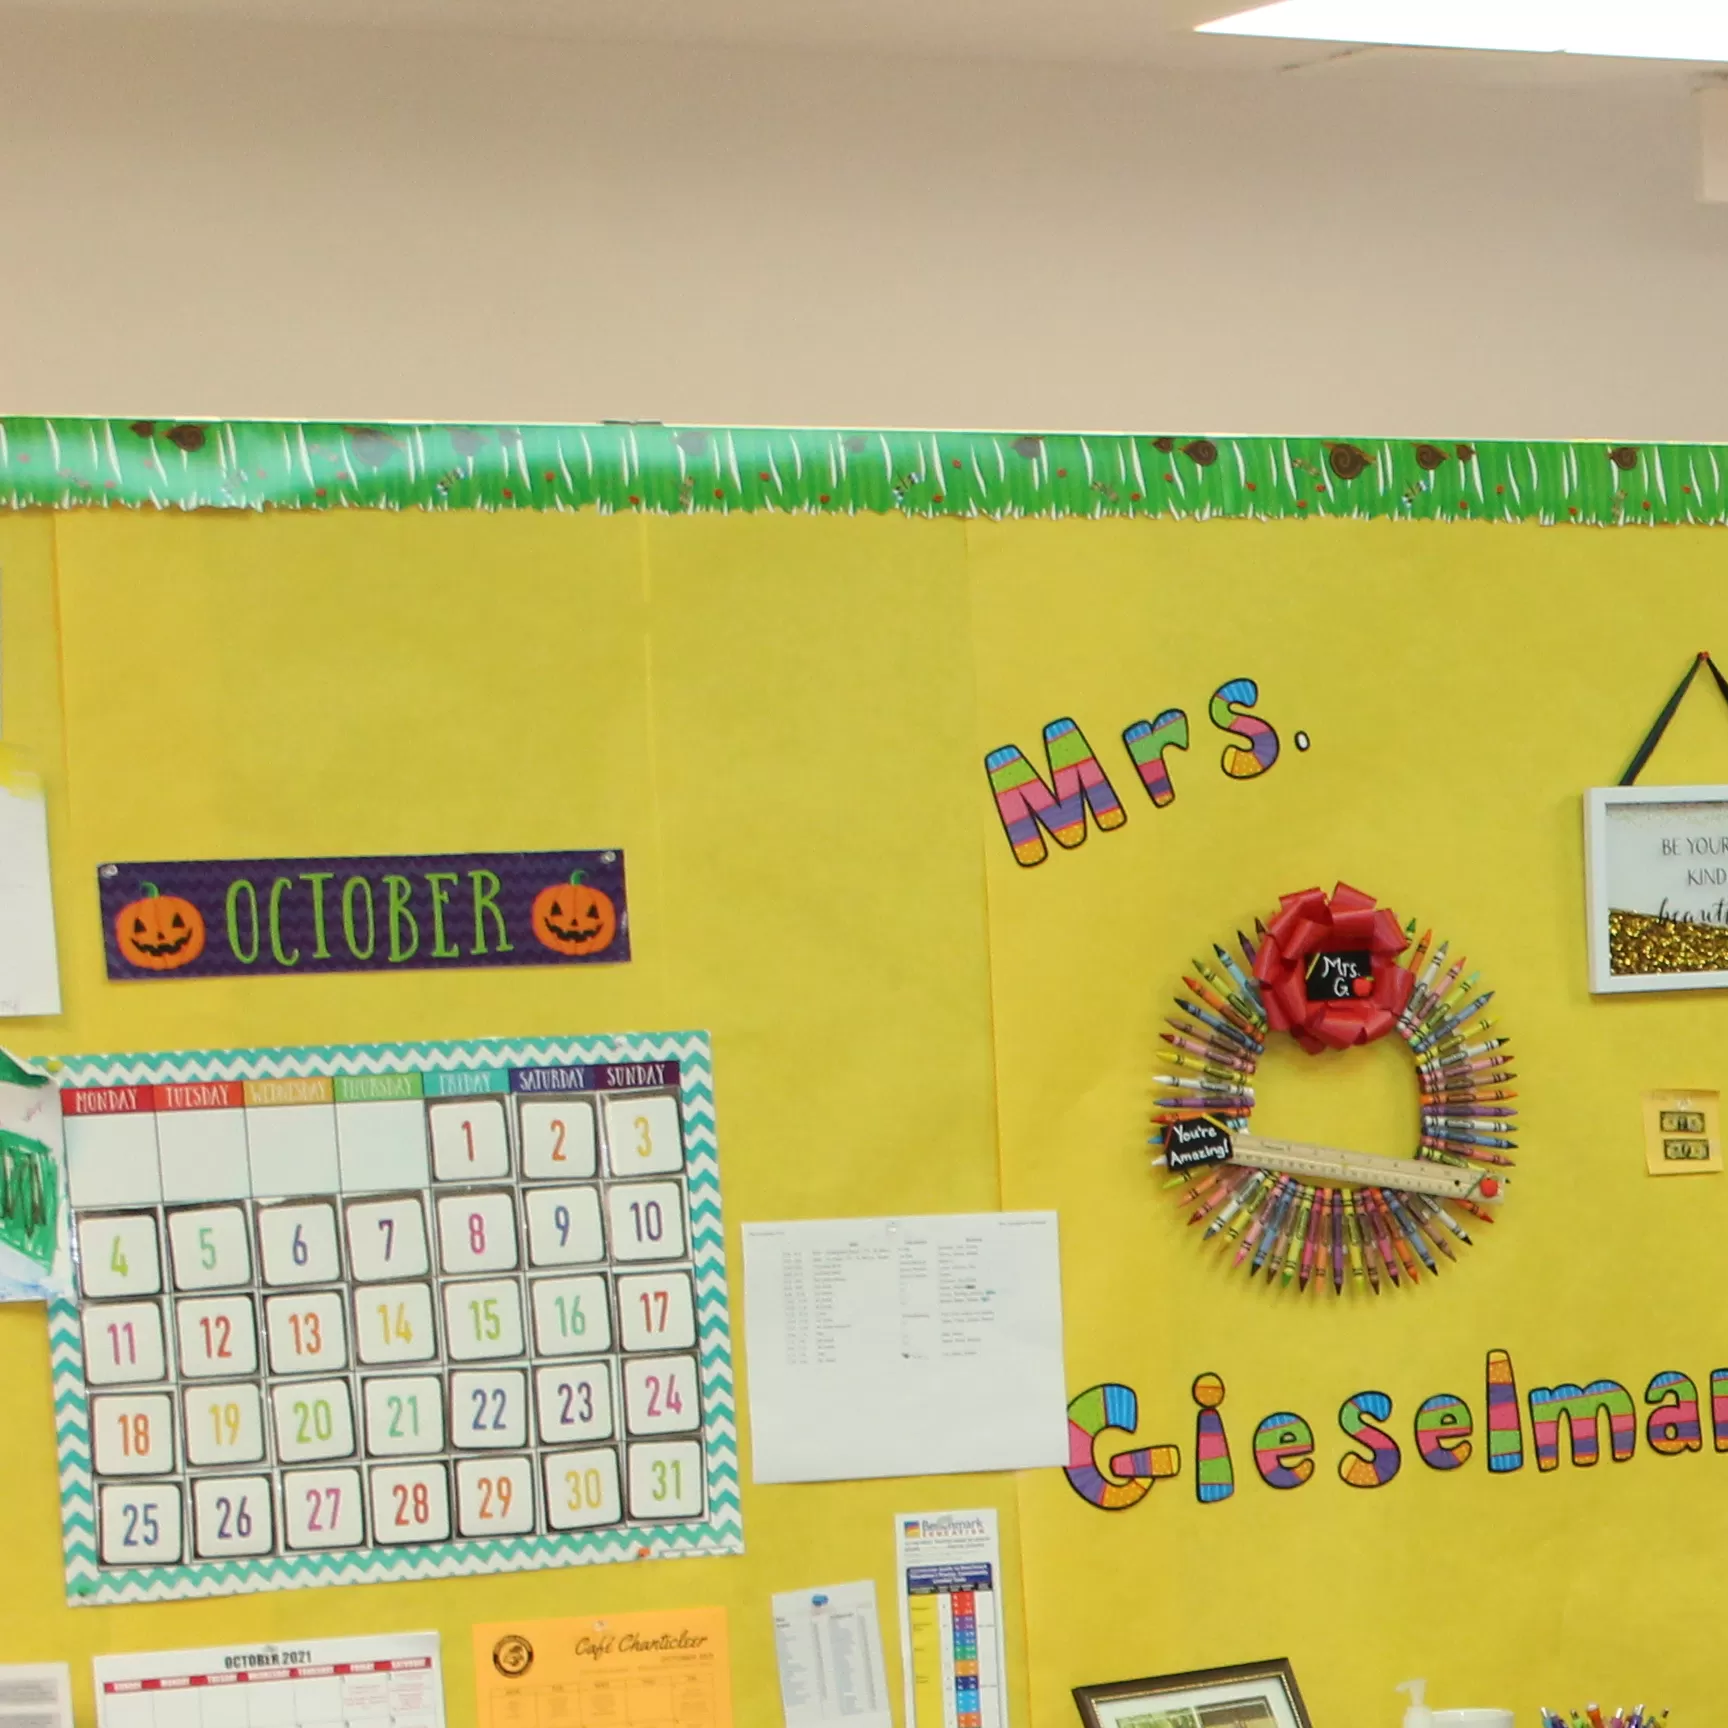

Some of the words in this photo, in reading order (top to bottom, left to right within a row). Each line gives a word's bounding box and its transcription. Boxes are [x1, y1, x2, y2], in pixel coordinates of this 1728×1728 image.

[984, 677, 1310, 868] Mrs.
[1661, 838, 1680, 856] BE
[1687, 868, 1727, 886] KIND
[225, 869, 513, 966] OCTOBER
[1321, 956, 1361, 979] Mrs.
[75, 1086, 138, 1113] MONDAY
[165, 1082, 231, 1109] TUESDAY
[438, 1069, 491, 1095] FRIDAY
[519, 1063, 586, 1092] SATURDAY
[606, 1061, 667, 1090] SUNDAY
[461, 1120, 476, 1162] 1
[550, 1120, 567, 1162] 2
[635, 1116, 653, 1158] 3
[1170, 1139, 1230, 1167] Amazing!
[1173, 1124, 1218, 1144] You're
[110, 1236, 129, 1277] 4
[200, 1228, 217, 1271] 5
[292, 1226, 309, 1267] 6
[378, 1220, 395, 1262] 7
[468, 1213, 486, 1254] 8
[555, 1206, 571, 1247] 9
[631, 1201, 663, 1243] 10
[107, 1322, 137, 1365] 11
[200, 1316, 232, 1359] 12
[290, 1312, 322, 1355] 13
[378, 1303, 413, 1345] 14
[470, 1298, 502, 1342] 15
[556, 1295, 587, 1338] 16
[641, 1291, 669, 1333] 17
[118, 1413, 151, 1457] 18
[210, 1403, 241, 1447] 19
[295, 1400, 332, 1443] 20
[387, 1396, 420, 1438] 21
[471, 1389, 507, 1430] 22
[558, 1382, 594, 1425] 23
[645, 1373, 682, 1416] 24
[122, 1503, 159, 1547] 25
[215, 1497, 252, 1540] 26
[306, 1488, 342, 1532] 27
[392, 1483, 429, 1527] 28
[477, 1476, 512, 1519] 29
[565, 1468, 602, 1511] 30
[651, 1459, 682, 1500] 31
[224, 1652, 280, 1669] OCTOBER
[283, 1650, 313, 1666] 2021
